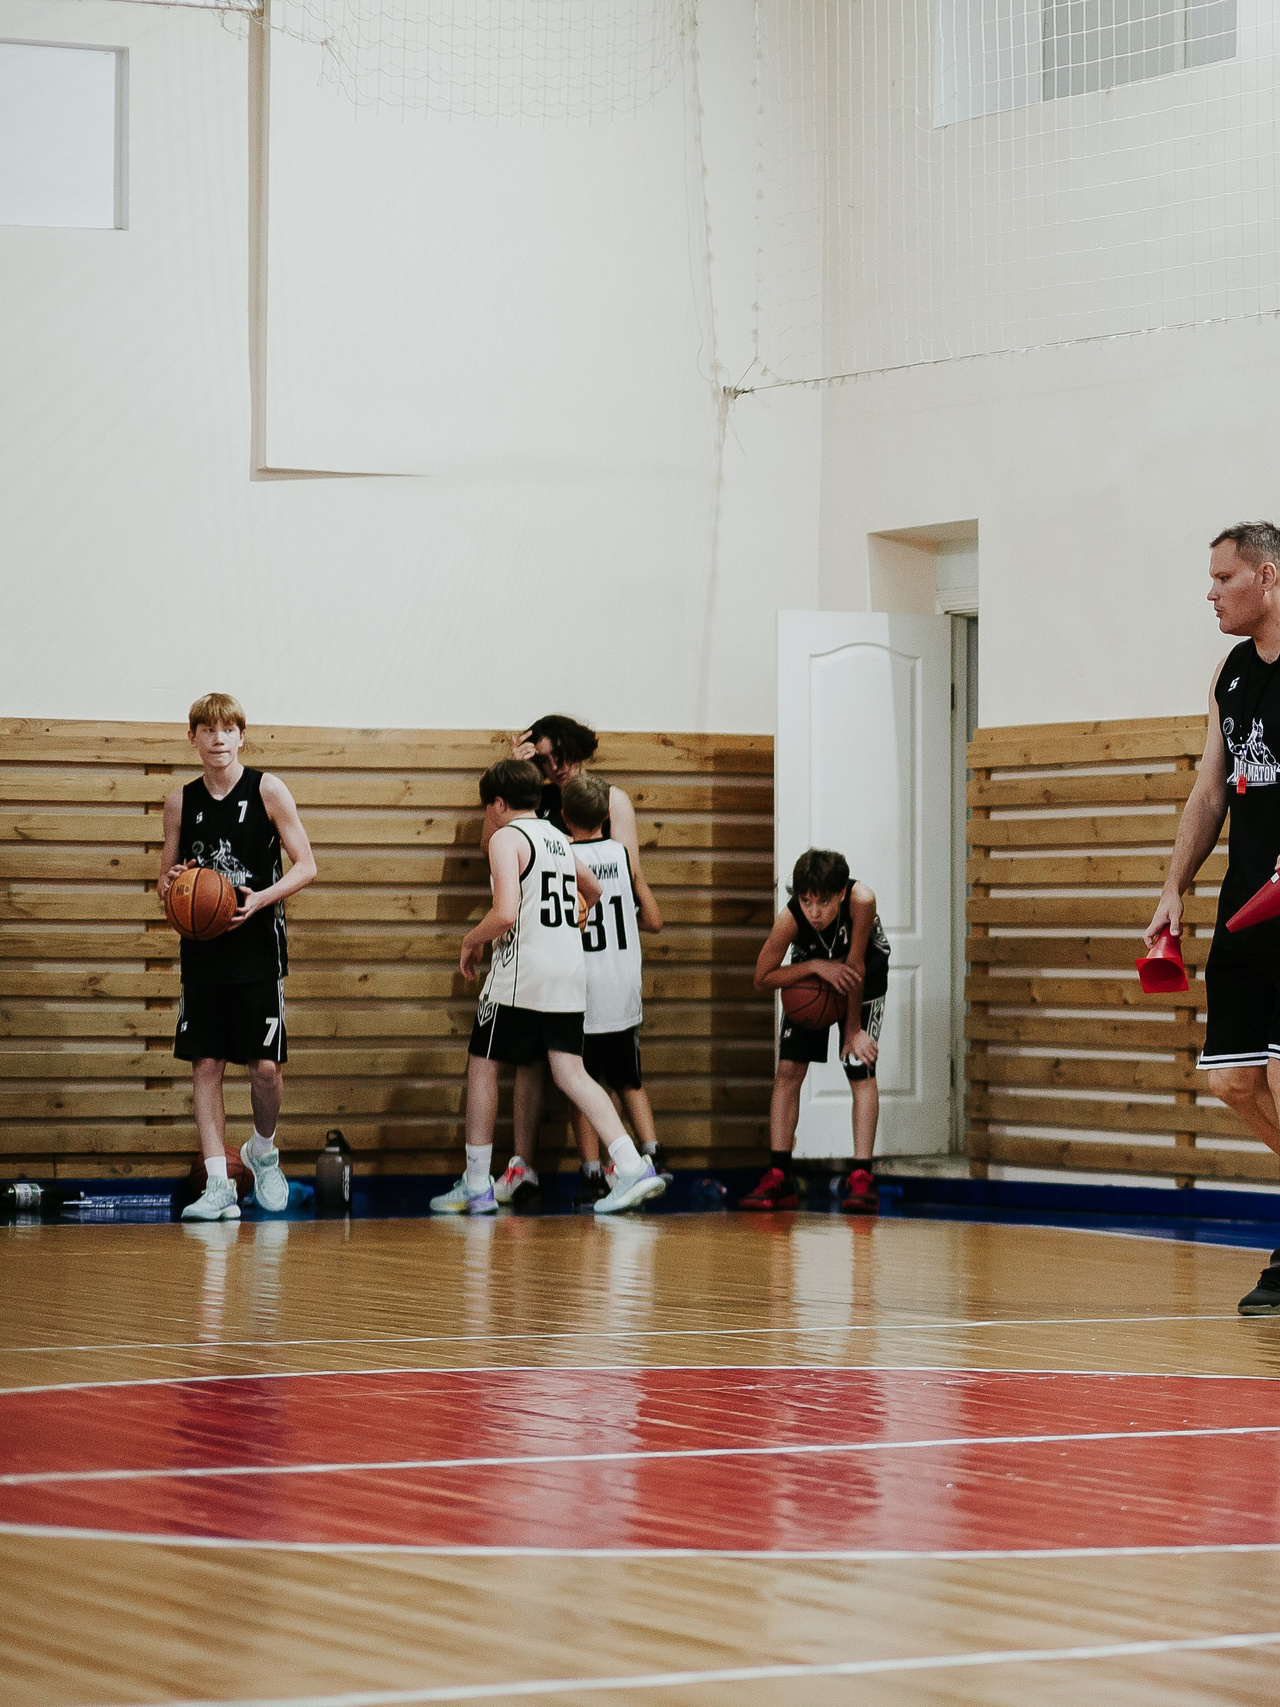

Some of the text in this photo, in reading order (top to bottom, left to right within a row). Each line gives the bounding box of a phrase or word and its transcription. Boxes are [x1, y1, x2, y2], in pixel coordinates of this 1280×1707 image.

[238, 800, 248, 823] 7
[540, 870, 579, 928] 55
[581, 894, 627, 952] 31
[262, 1017, 279, 1047] 7
